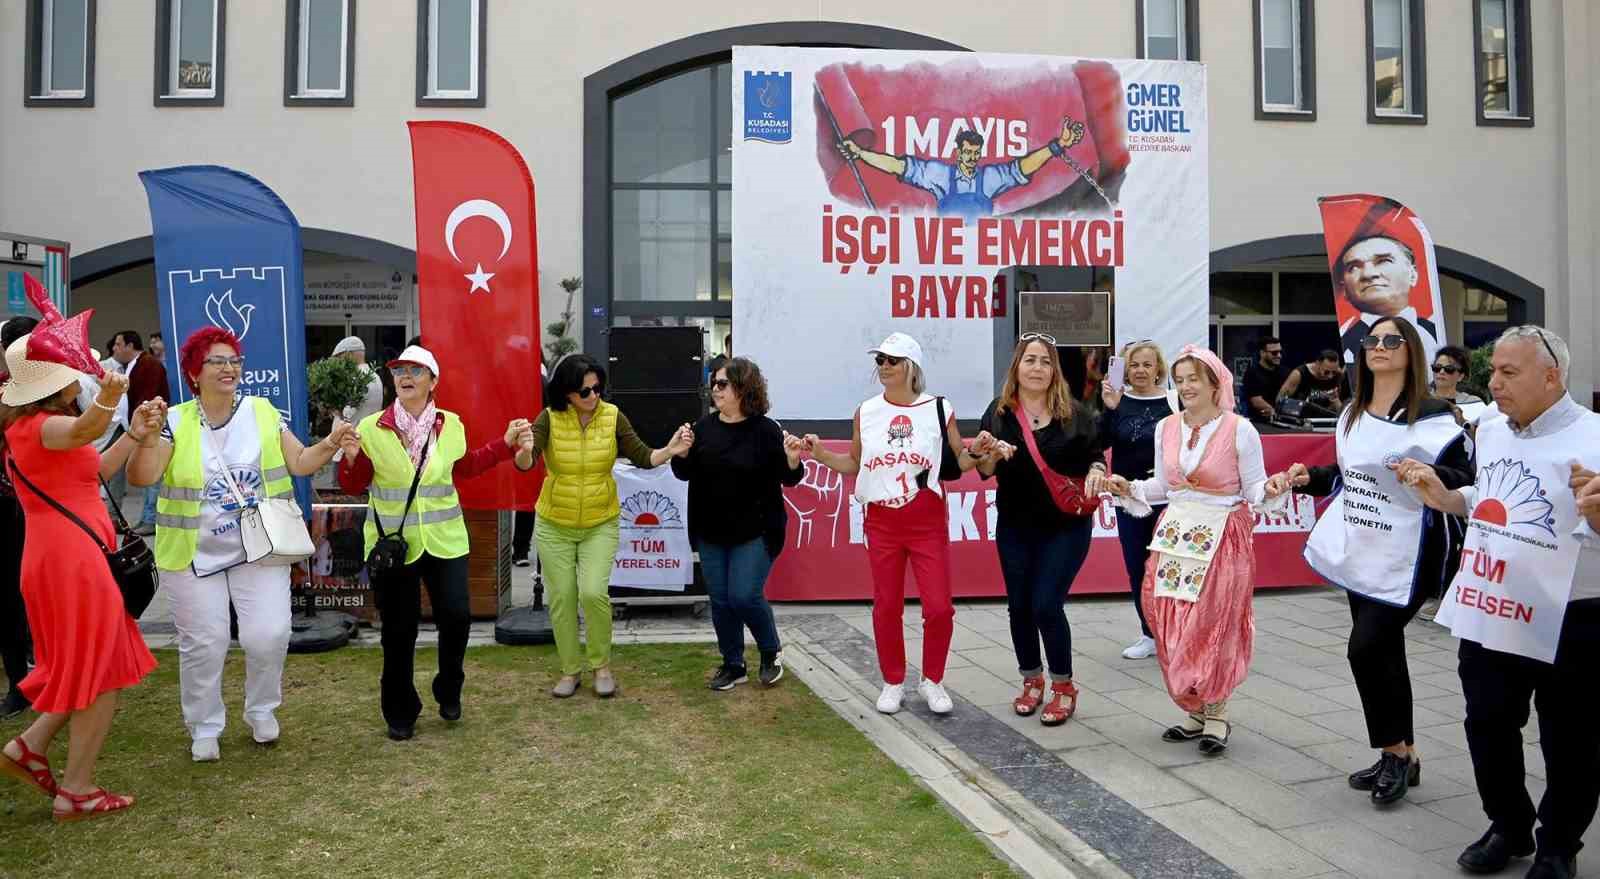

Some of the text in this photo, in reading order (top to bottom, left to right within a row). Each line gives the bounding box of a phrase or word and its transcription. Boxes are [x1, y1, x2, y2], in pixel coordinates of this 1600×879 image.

[1127, 83, 1181, 107] ÖMER
[1127, 109, 1191, 133] GÜNEL
[881, 116, 1028, 158] 1 MAYIS
[822, 204, 900, 275] İŞÇİ
[914, 217, 964, 266] VE
[895, 472, 909, 496] 1
[630, 537, 665, 553] TÜM
[614, 558, 681, 569] YEREL-SEN
[290, 594, 365, 607] BEEDİYESİ
